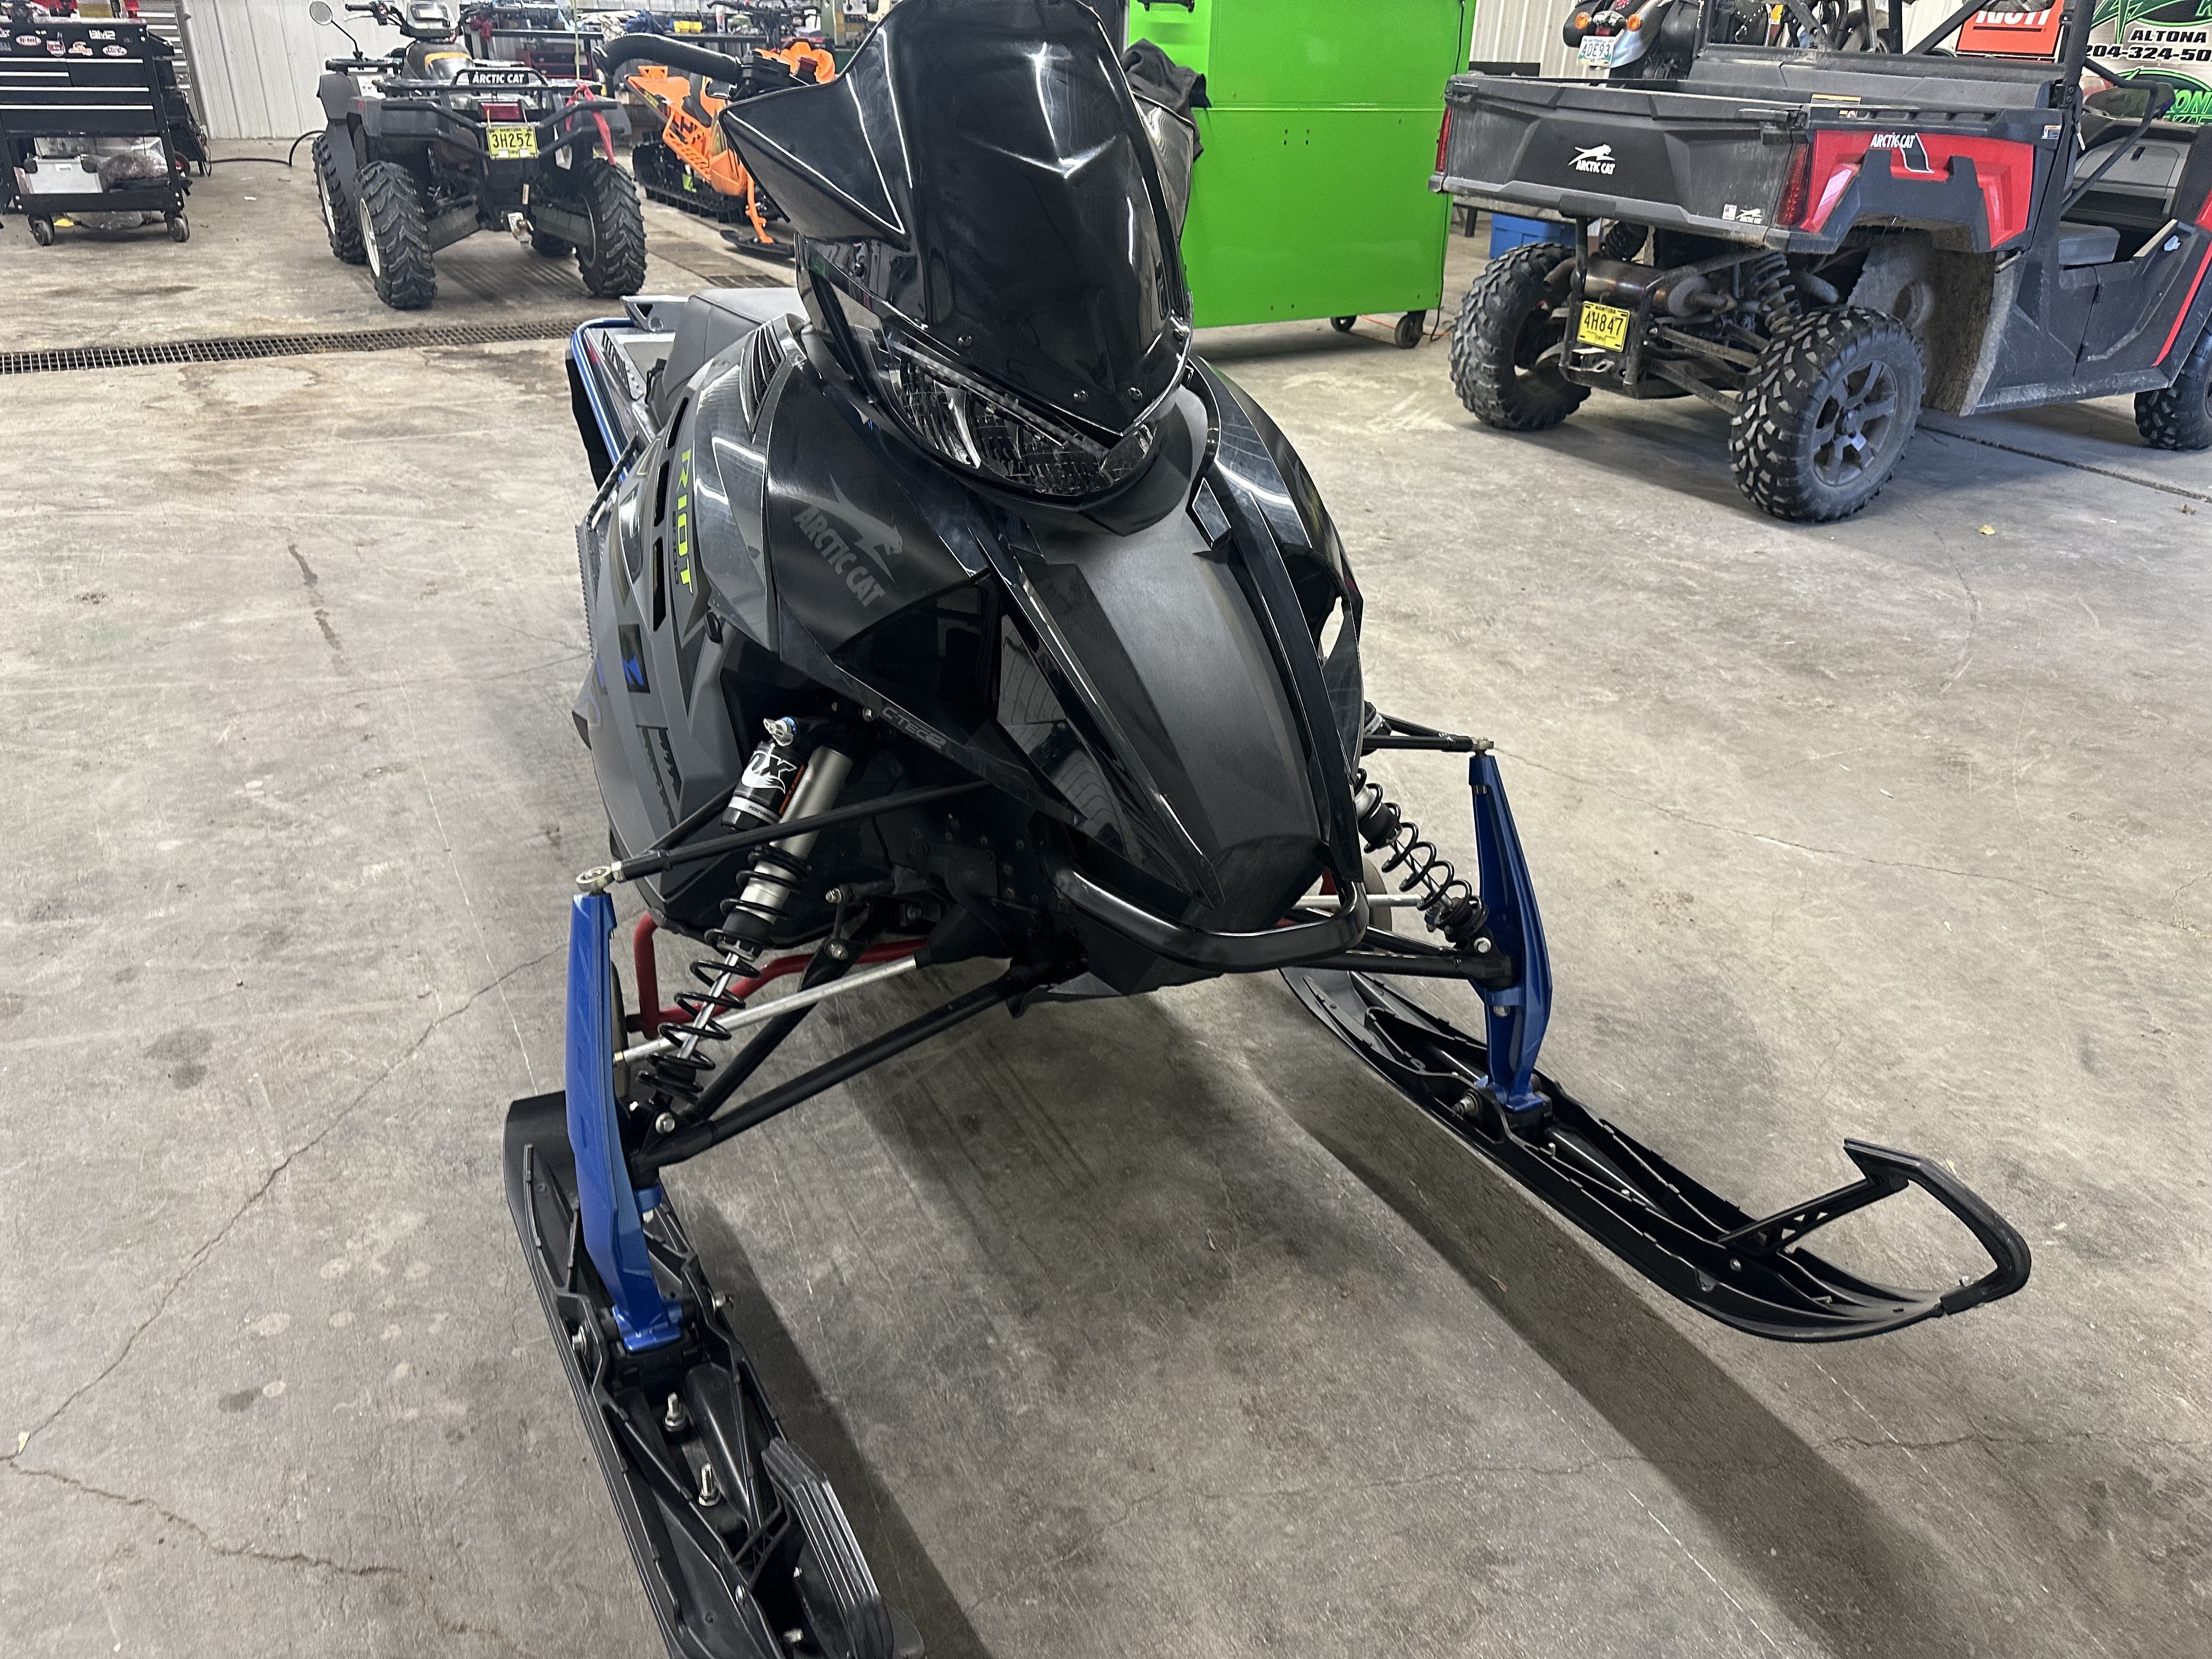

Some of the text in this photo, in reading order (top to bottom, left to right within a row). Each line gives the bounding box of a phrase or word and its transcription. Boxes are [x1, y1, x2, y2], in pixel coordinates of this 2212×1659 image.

[2130, 30, 2207, 43] ALTONA
[1582, 43, 1610, 58] 4DE93
[2086, 45, 2212, 61] 204-324-50
[472, 74, 524, 83] ARCTIC CAT
[492, 133, 533, 148] 3H252
[1870, 133, 1916, 148] ARCTIC CAT
[1576, 160, 1616, 174] ARCTIC CAT
[1584, 310, 1624, 336] 4H847
[676, 448, 694, 596] RIOT
[793, 506, 886, 607] ARCTIC CAT
